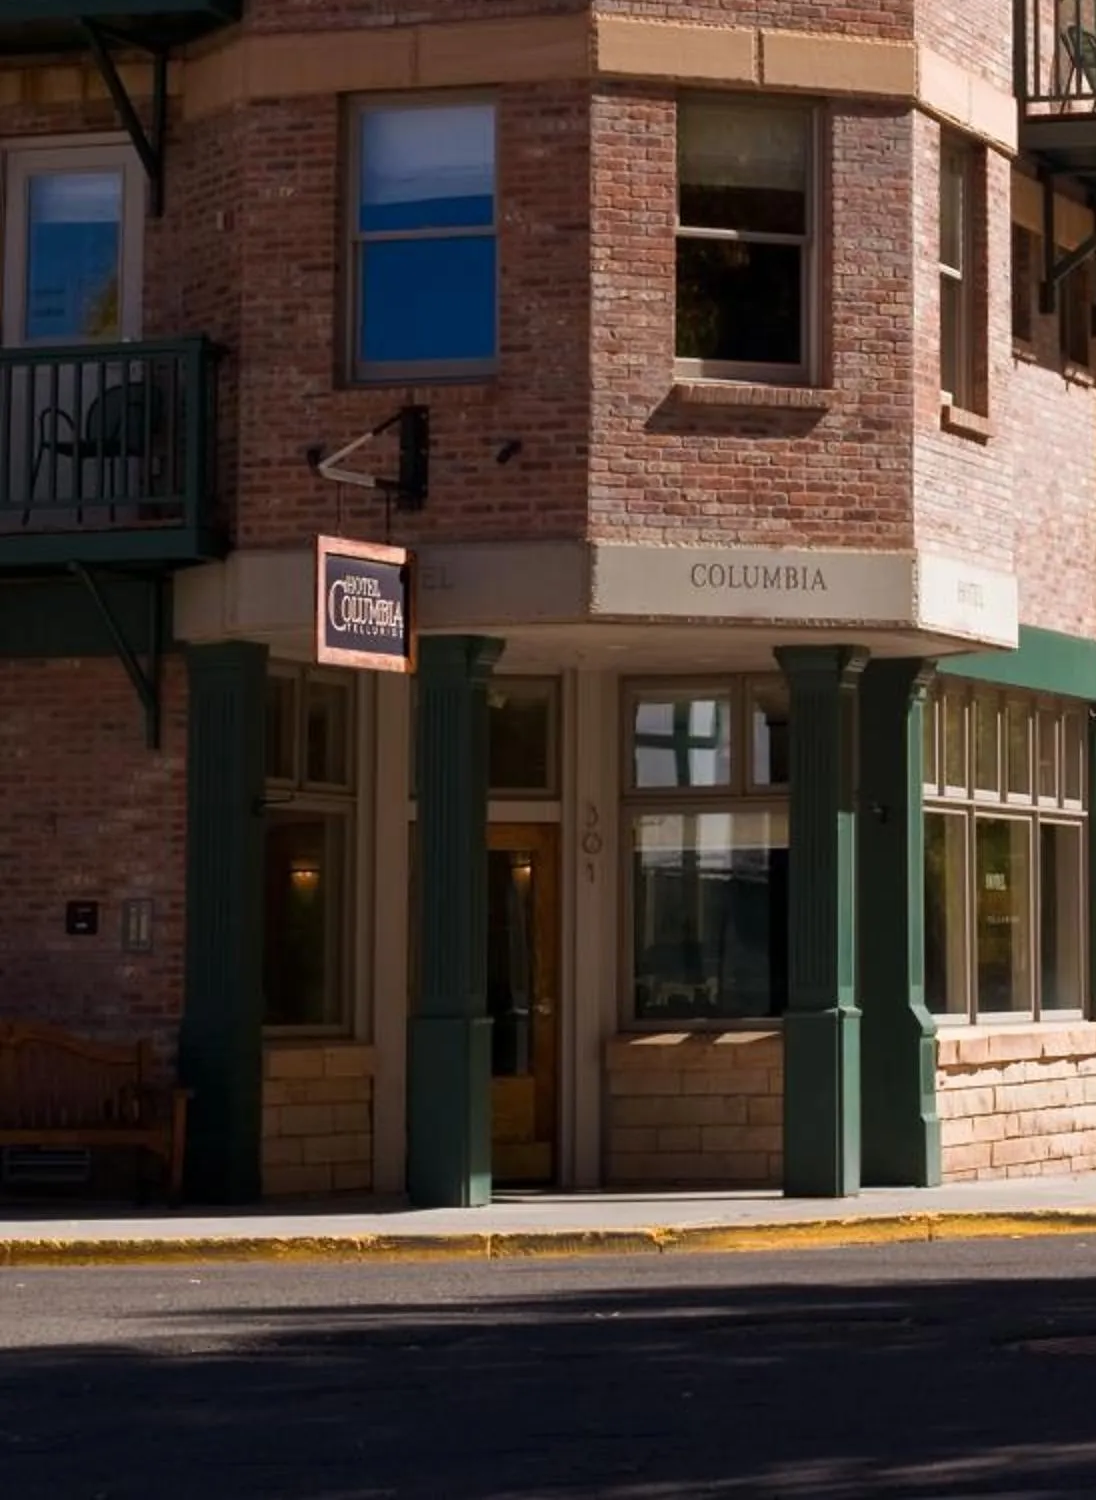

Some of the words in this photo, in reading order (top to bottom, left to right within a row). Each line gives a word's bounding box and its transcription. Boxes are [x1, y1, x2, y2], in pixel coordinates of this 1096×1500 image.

[345, 575, 381, 597] HOTEL
[691, 563, 828, 591] COLUMBIA
[329, 580, 404, 631] COLUMBIA
